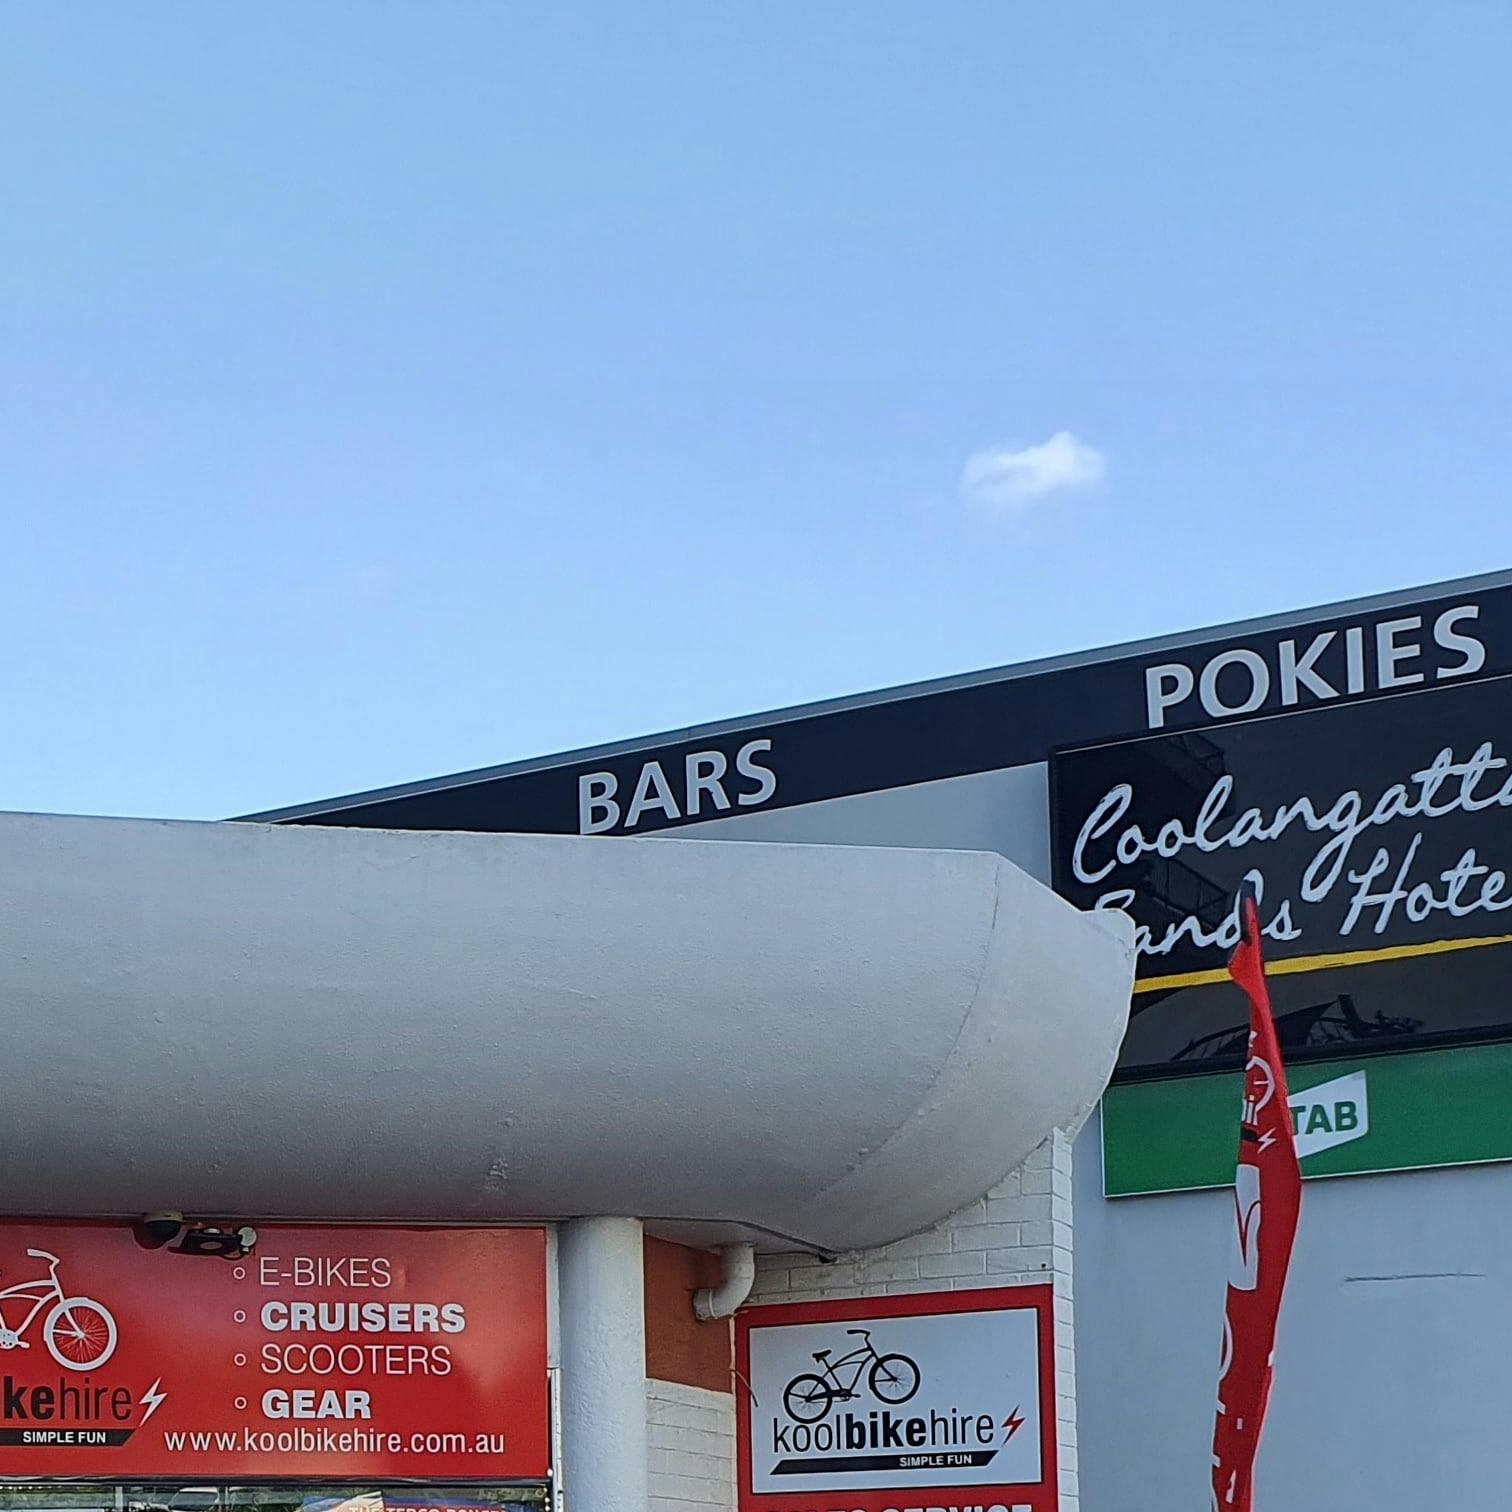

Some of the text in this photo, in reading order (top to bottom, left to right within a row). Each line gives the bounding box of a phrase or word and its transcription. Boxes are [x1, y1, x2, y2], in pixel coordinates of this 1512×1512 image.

[1145, 604, 1487, 729] POKIES
[578, 738, 778, 836] BARS
[1290, 1101, 1359, 1136] TAB
[260, 1256, 392, 1287] E-BIKES
[260, 1303, 466, 1334] CRUISERS
[260, 1344, 452, 1376] SCOOTERS
[261, 1390, 372, 1420] GEAR
[23, 1430, 107, 1444] SIMPLE FUN
[164, 1426, 506, 1455] www.koolbikehire.com.au
[772, 1406, 995, 1453] koolbikehire
[899, 1454, 973, 1467] SIMPLE FUN
